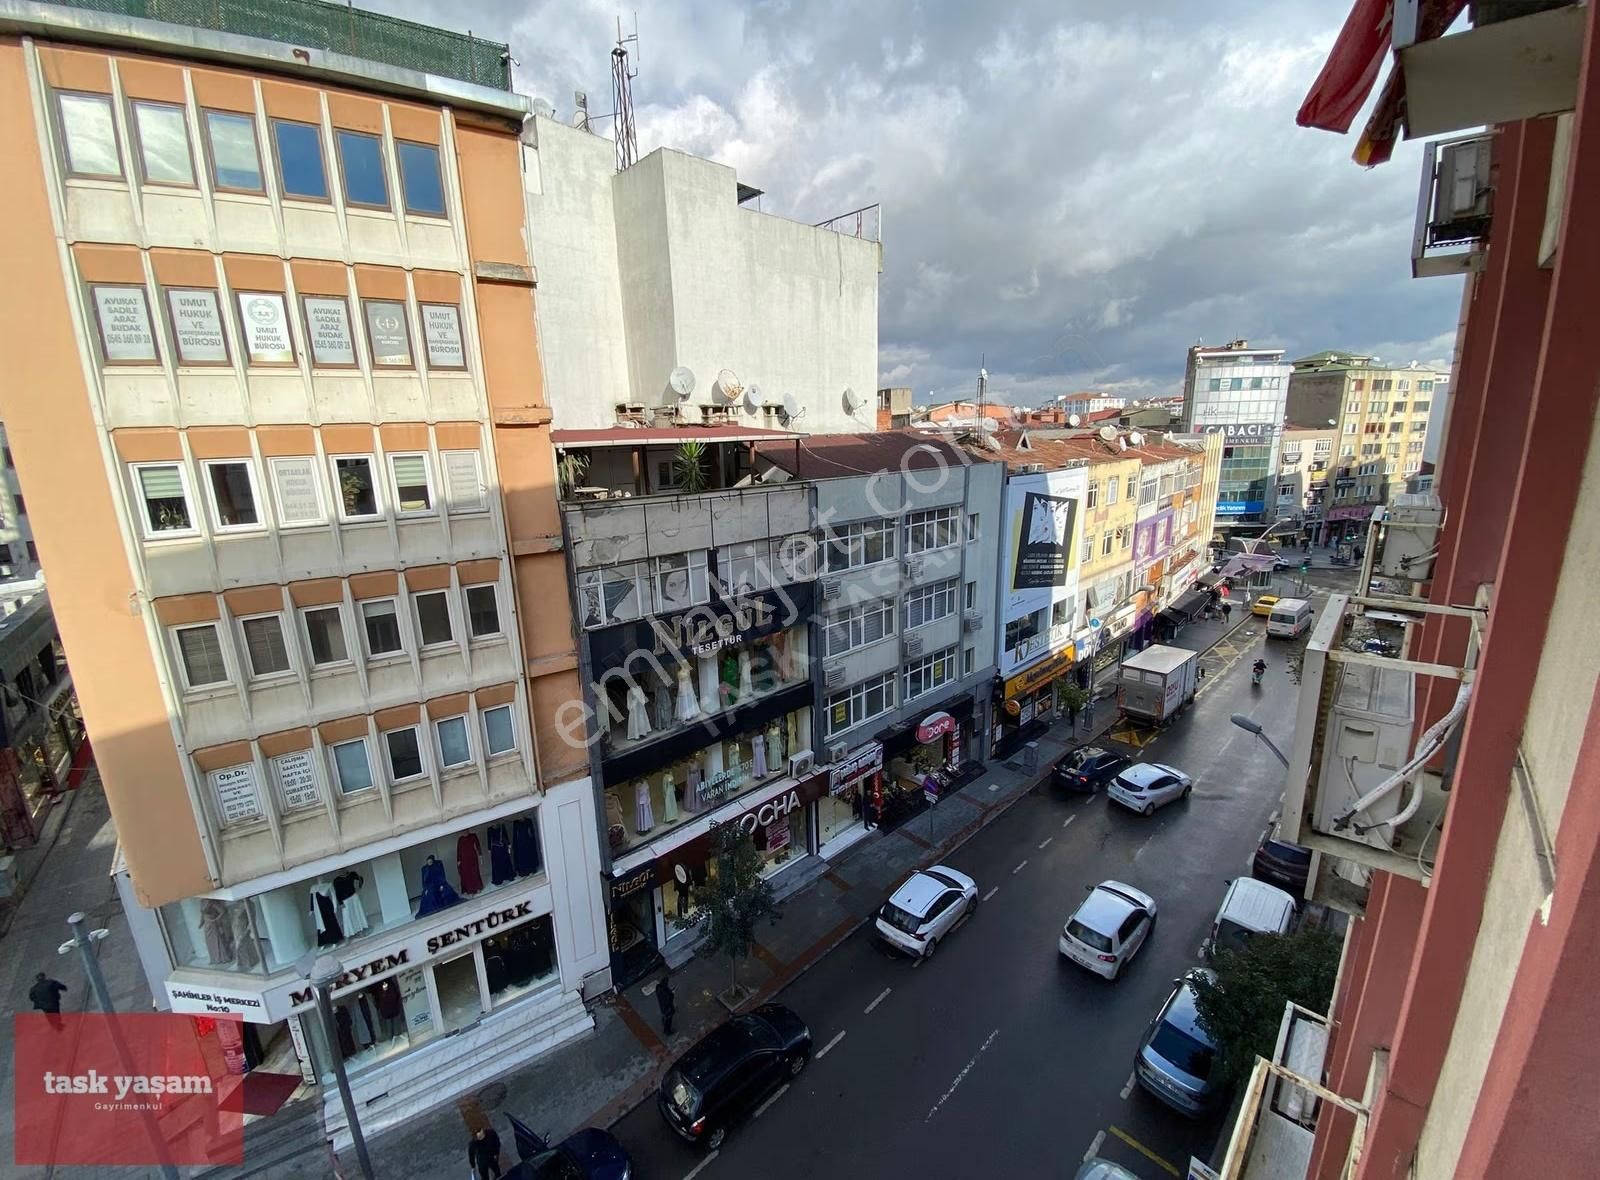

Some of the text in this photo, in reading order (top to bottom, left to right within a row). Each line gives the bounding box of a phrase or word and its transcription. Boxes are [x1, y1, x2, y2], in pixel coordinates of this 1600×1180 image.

[180, 298, 207, 307] UMUT
[180, 309, 212, 319] HUKUK
[430, 311, 450, 320] UMUT
[191, 321, 204, 329] VE
[429, 321, 455, 330] HUKUK
[255, 326, 278, 334] UMUT
[438, 331, 448, 339] VE
[182, 336, 221, 346] BÜROSU
[254, 342, 286, 350] BÜROSU
[430, 345, 460, 354] BÜROSU
[692, 634, 743, 656] TESETTÜR
[219, 769, 247, 781] Op.Dr.
[701, 782, 724, 801] VARAN
[738, 790, 802, 835] OCHA
[289, 949, 409, 1007] MRYEM
[427, 900, 533, 954] ŞENTÜRK
[223, 996, 260, 1008] MERKEZİ
